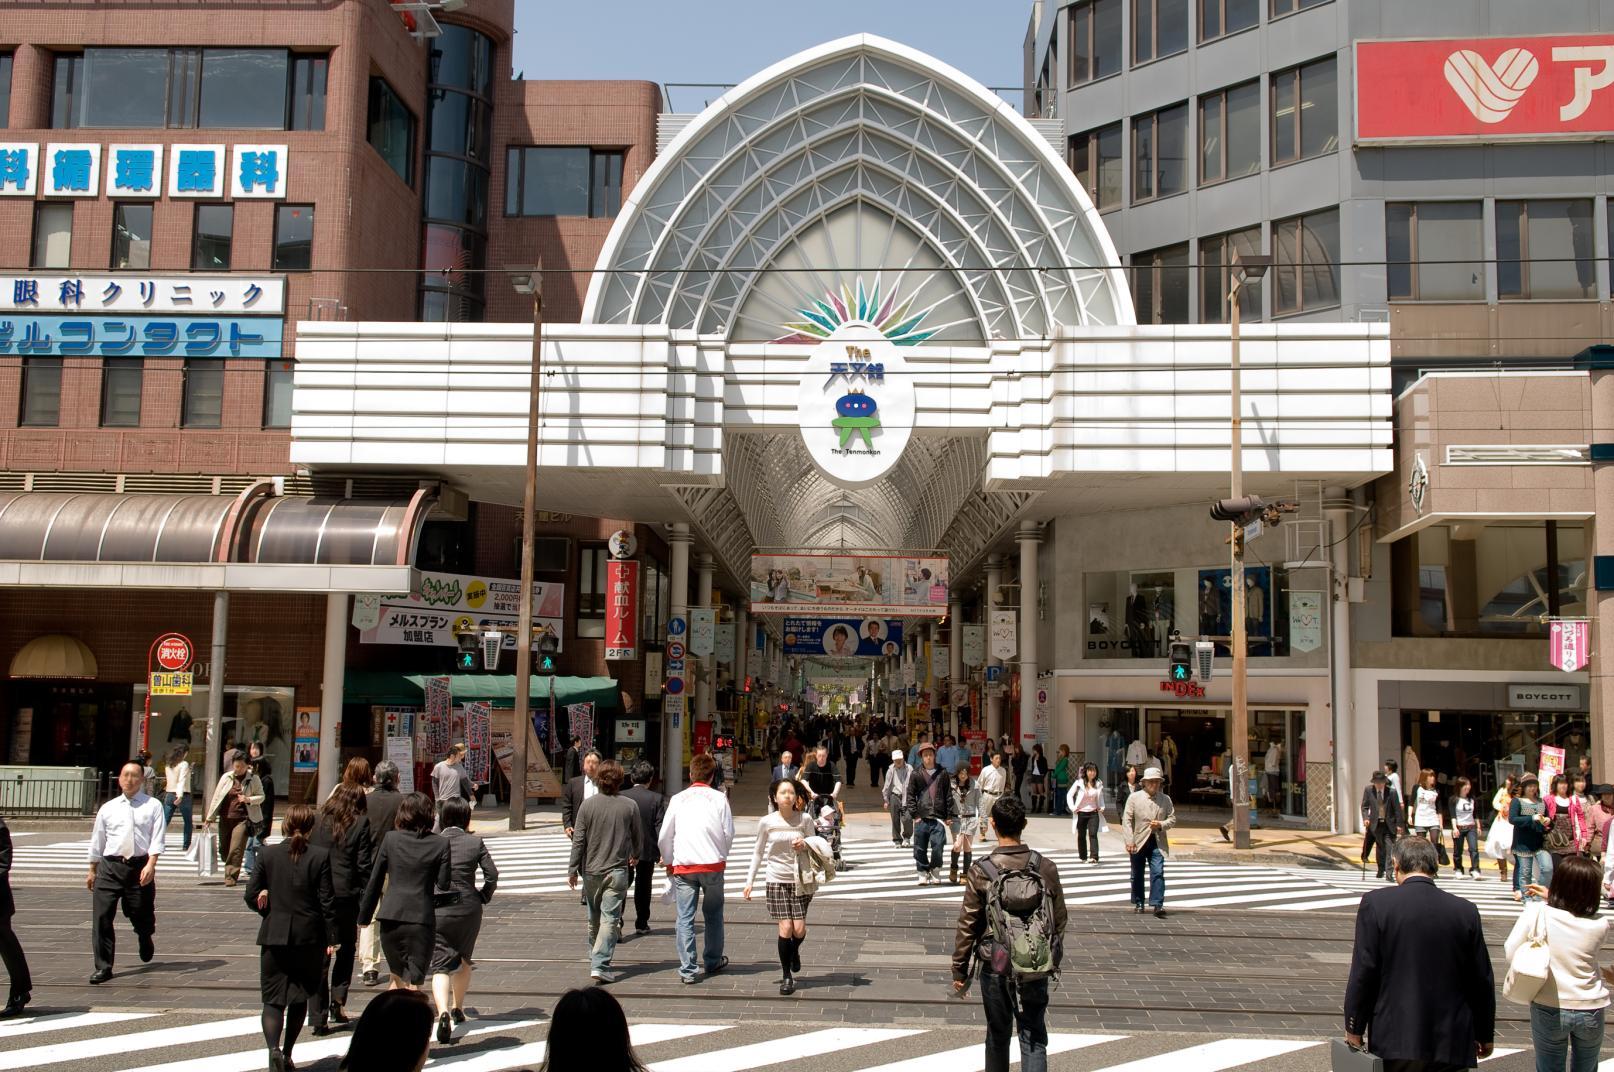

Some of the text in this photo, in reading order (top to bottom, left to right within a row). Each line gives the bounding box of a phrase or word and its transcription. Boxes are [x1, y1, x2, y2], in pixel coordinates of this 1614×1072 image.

[13, 279, 264, 305] 眼科クリニック
[845, 345, 871, 360] The
[823, 362, 885, 389] 天文館
[846, 448, 881, 456] Tenmonkan
[612, 581, 629, 644] 献血ルーム
[389, 613, 448, 629] メルスプラン
[403, 630, 434, 643] 加盟店
[160, 647, 186, 660] 消火栓
[609, 649, 622, 657] 2F
